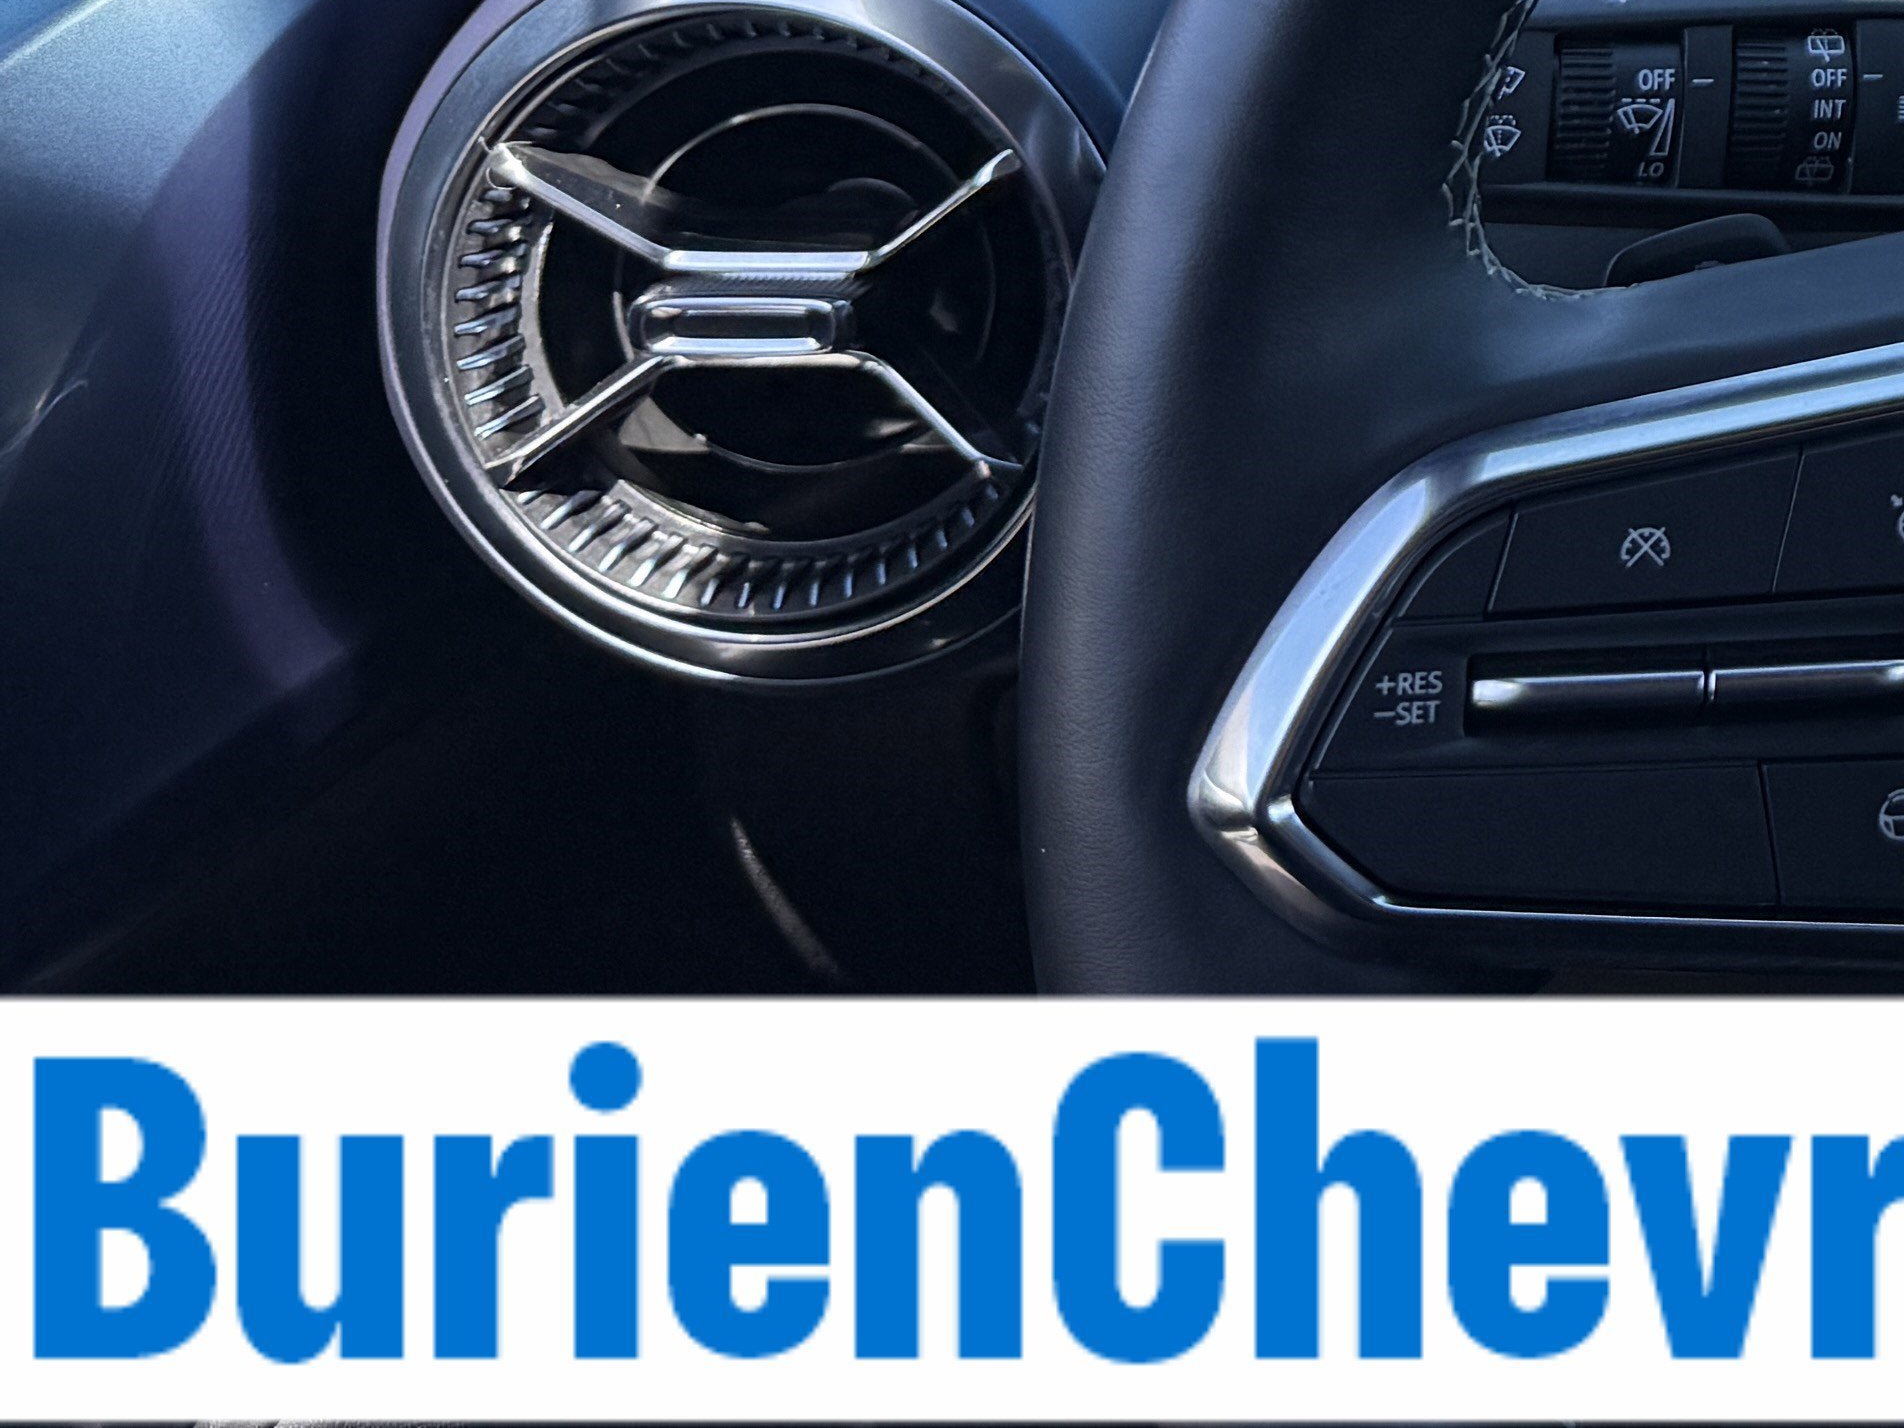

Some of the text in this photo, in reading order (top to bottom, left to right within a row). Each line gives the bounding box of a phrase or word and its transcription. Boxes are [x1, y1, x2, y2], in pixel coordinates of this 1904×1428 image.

[1638, 69, 1676, 91] OFF
[1812, 69, 1847, 89] OFF
[1813, 100, 1846, 120] INT
[1813, 132, 1842, 151] ON
[1637, 162, 1664, 178] LO
